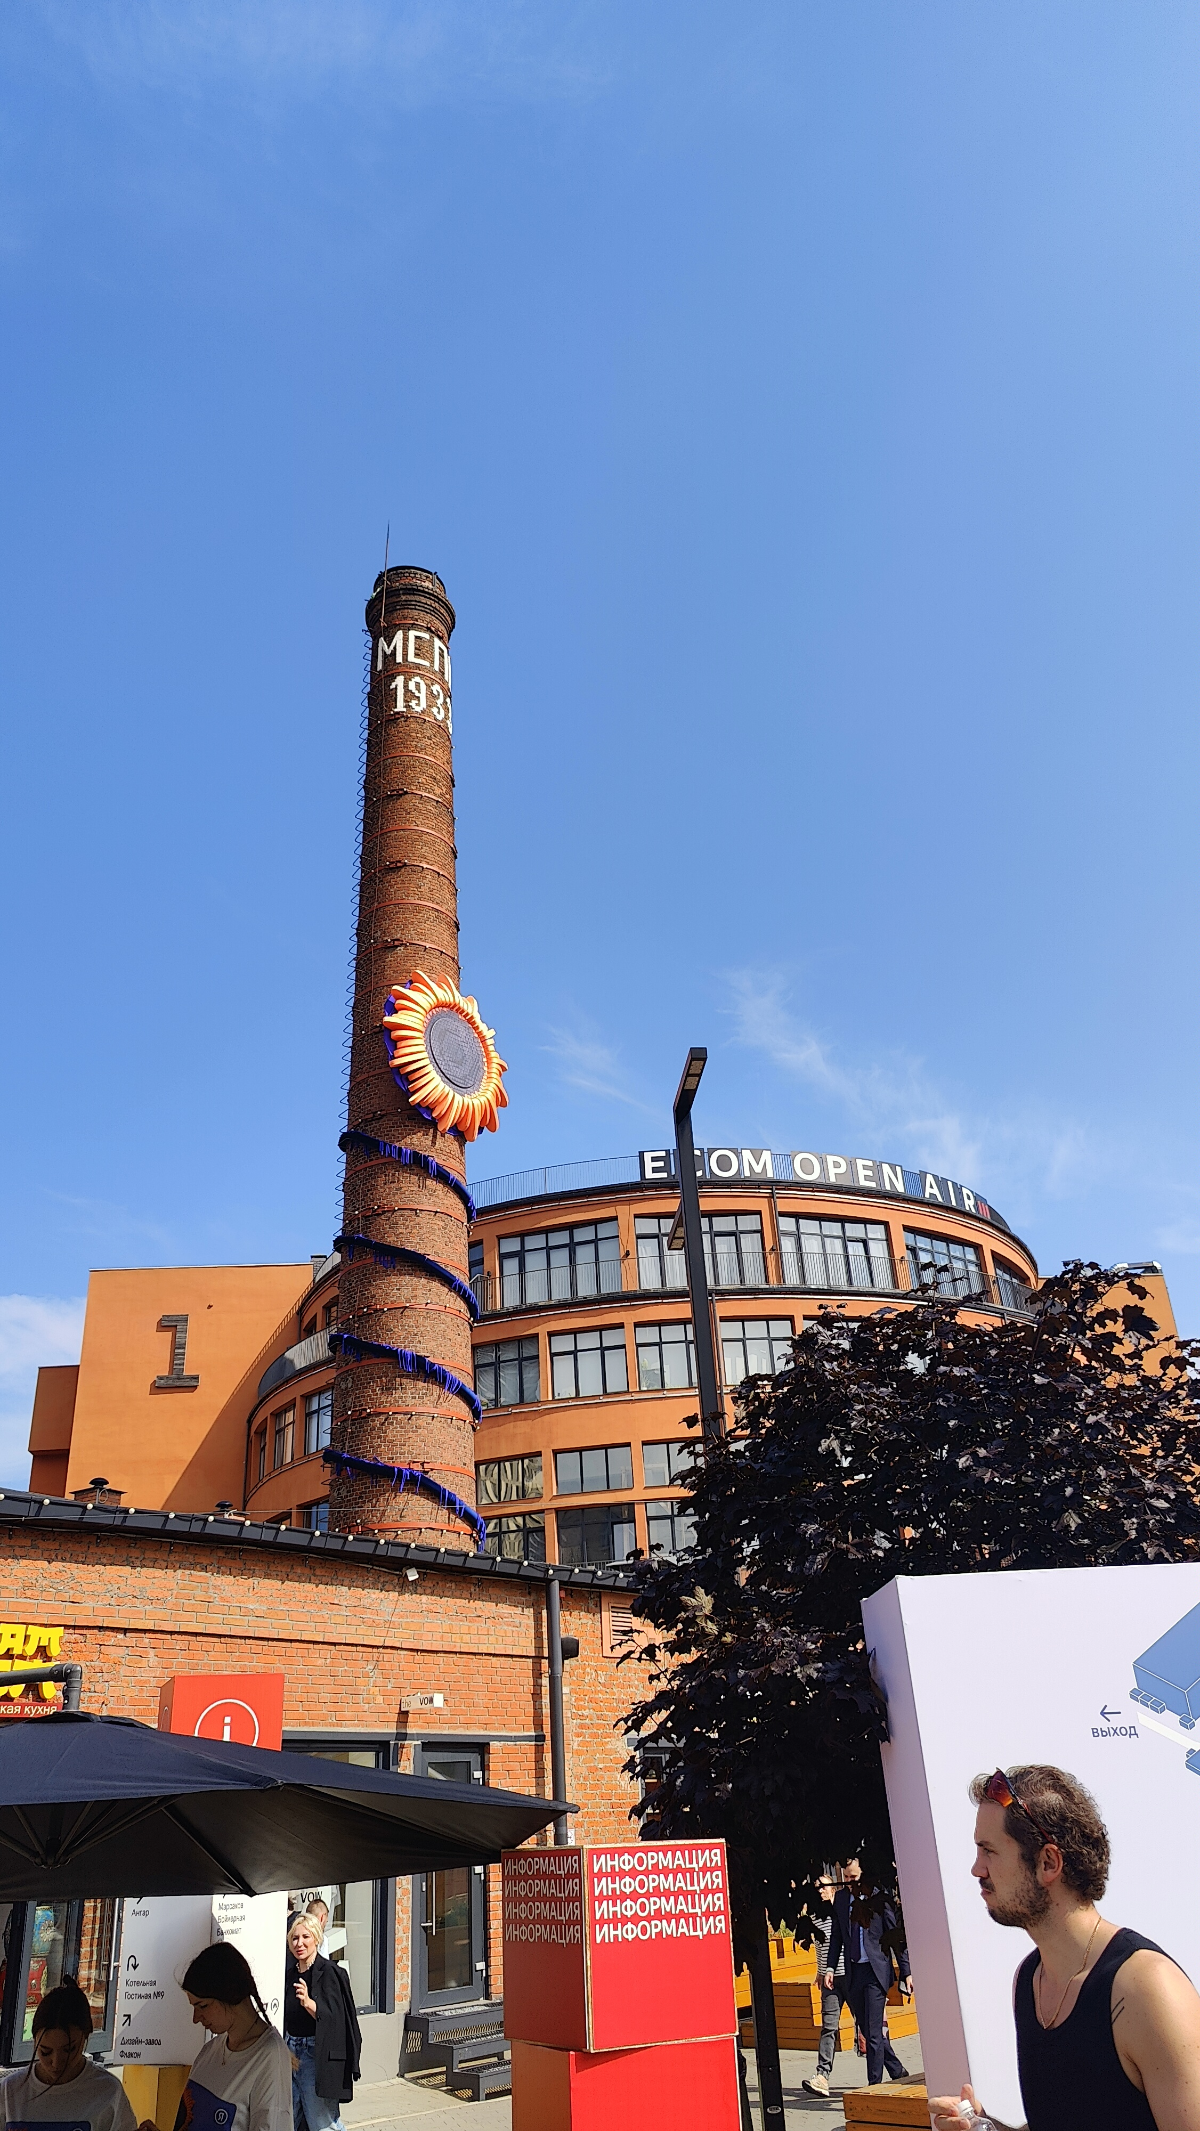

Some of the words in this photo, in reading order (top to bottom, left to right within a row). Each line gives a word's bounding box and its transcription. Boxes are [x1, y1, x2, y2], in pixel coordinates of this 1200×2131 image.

[793, 1152, 905, 1193] OPEN
[155, 1314, 200, 1388] 1
[24, 1705, 57, 1718] кухня
[1091, 1726, 1139, 1739] ВЫХОД
[504, 1855, 580, 1878] ИНФОРМАЦИЯ
[593, 1848, 722, 1874] ИНФОРМАЦИЯ
[504, 1878, 580, 1901] ИНФОРМАЦИЯ
[593, 1870, 723, 1897] ИНФОРМАЦИЯ
[505, 1901, 581, 1925] ИНФОРМАЦИЯ
[594, 1892, 725, 1920] ИНФОРМАЦИЯ
[505, 1924, 582, 1948] ИНФОРМАЦИЯ
[595, 1914, 726, 1944] ИНФОРМАЦИЯ
[125, 1979, 157, 1987] Котельная
